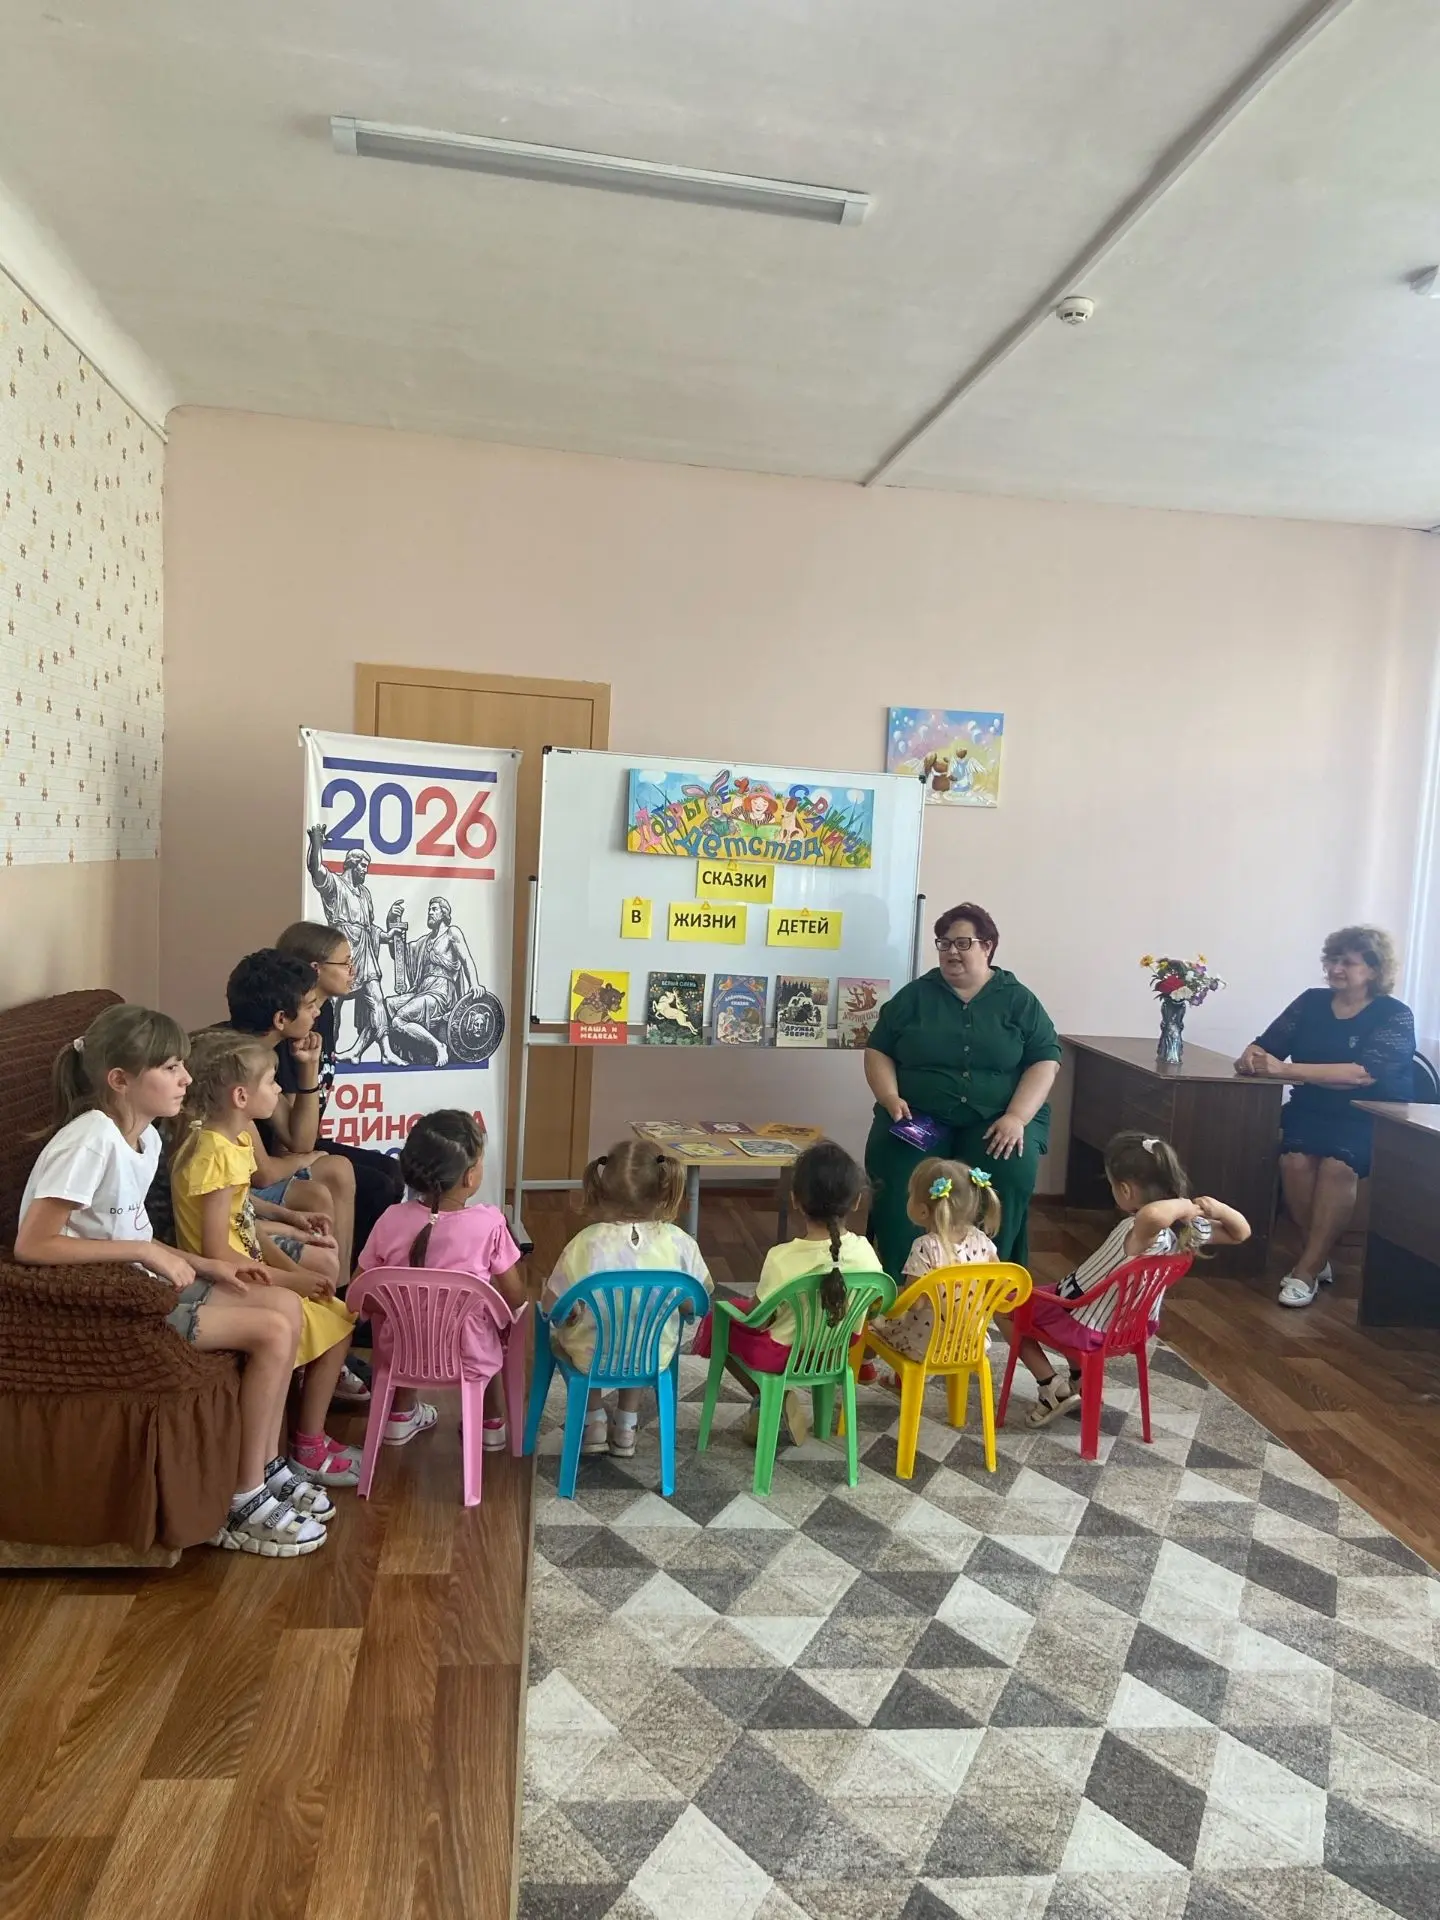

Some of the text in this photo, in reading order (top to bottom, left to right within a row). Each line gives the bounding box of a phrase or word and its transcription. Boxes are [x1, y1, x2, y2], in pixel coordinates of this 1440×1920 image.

[321, 778, 497, 859] 2026
[702, 870, 767, 888] СКАЗКИ
[631, 909, 828, 936] В ЖИЗНИ ДЕТЕЙ
[580, 1025, 607, 1033] МАША
[580, 1032, 618, 1040] МЕДВЕДЬ
[319, 1111, 487, 1147] ЕДИНА
